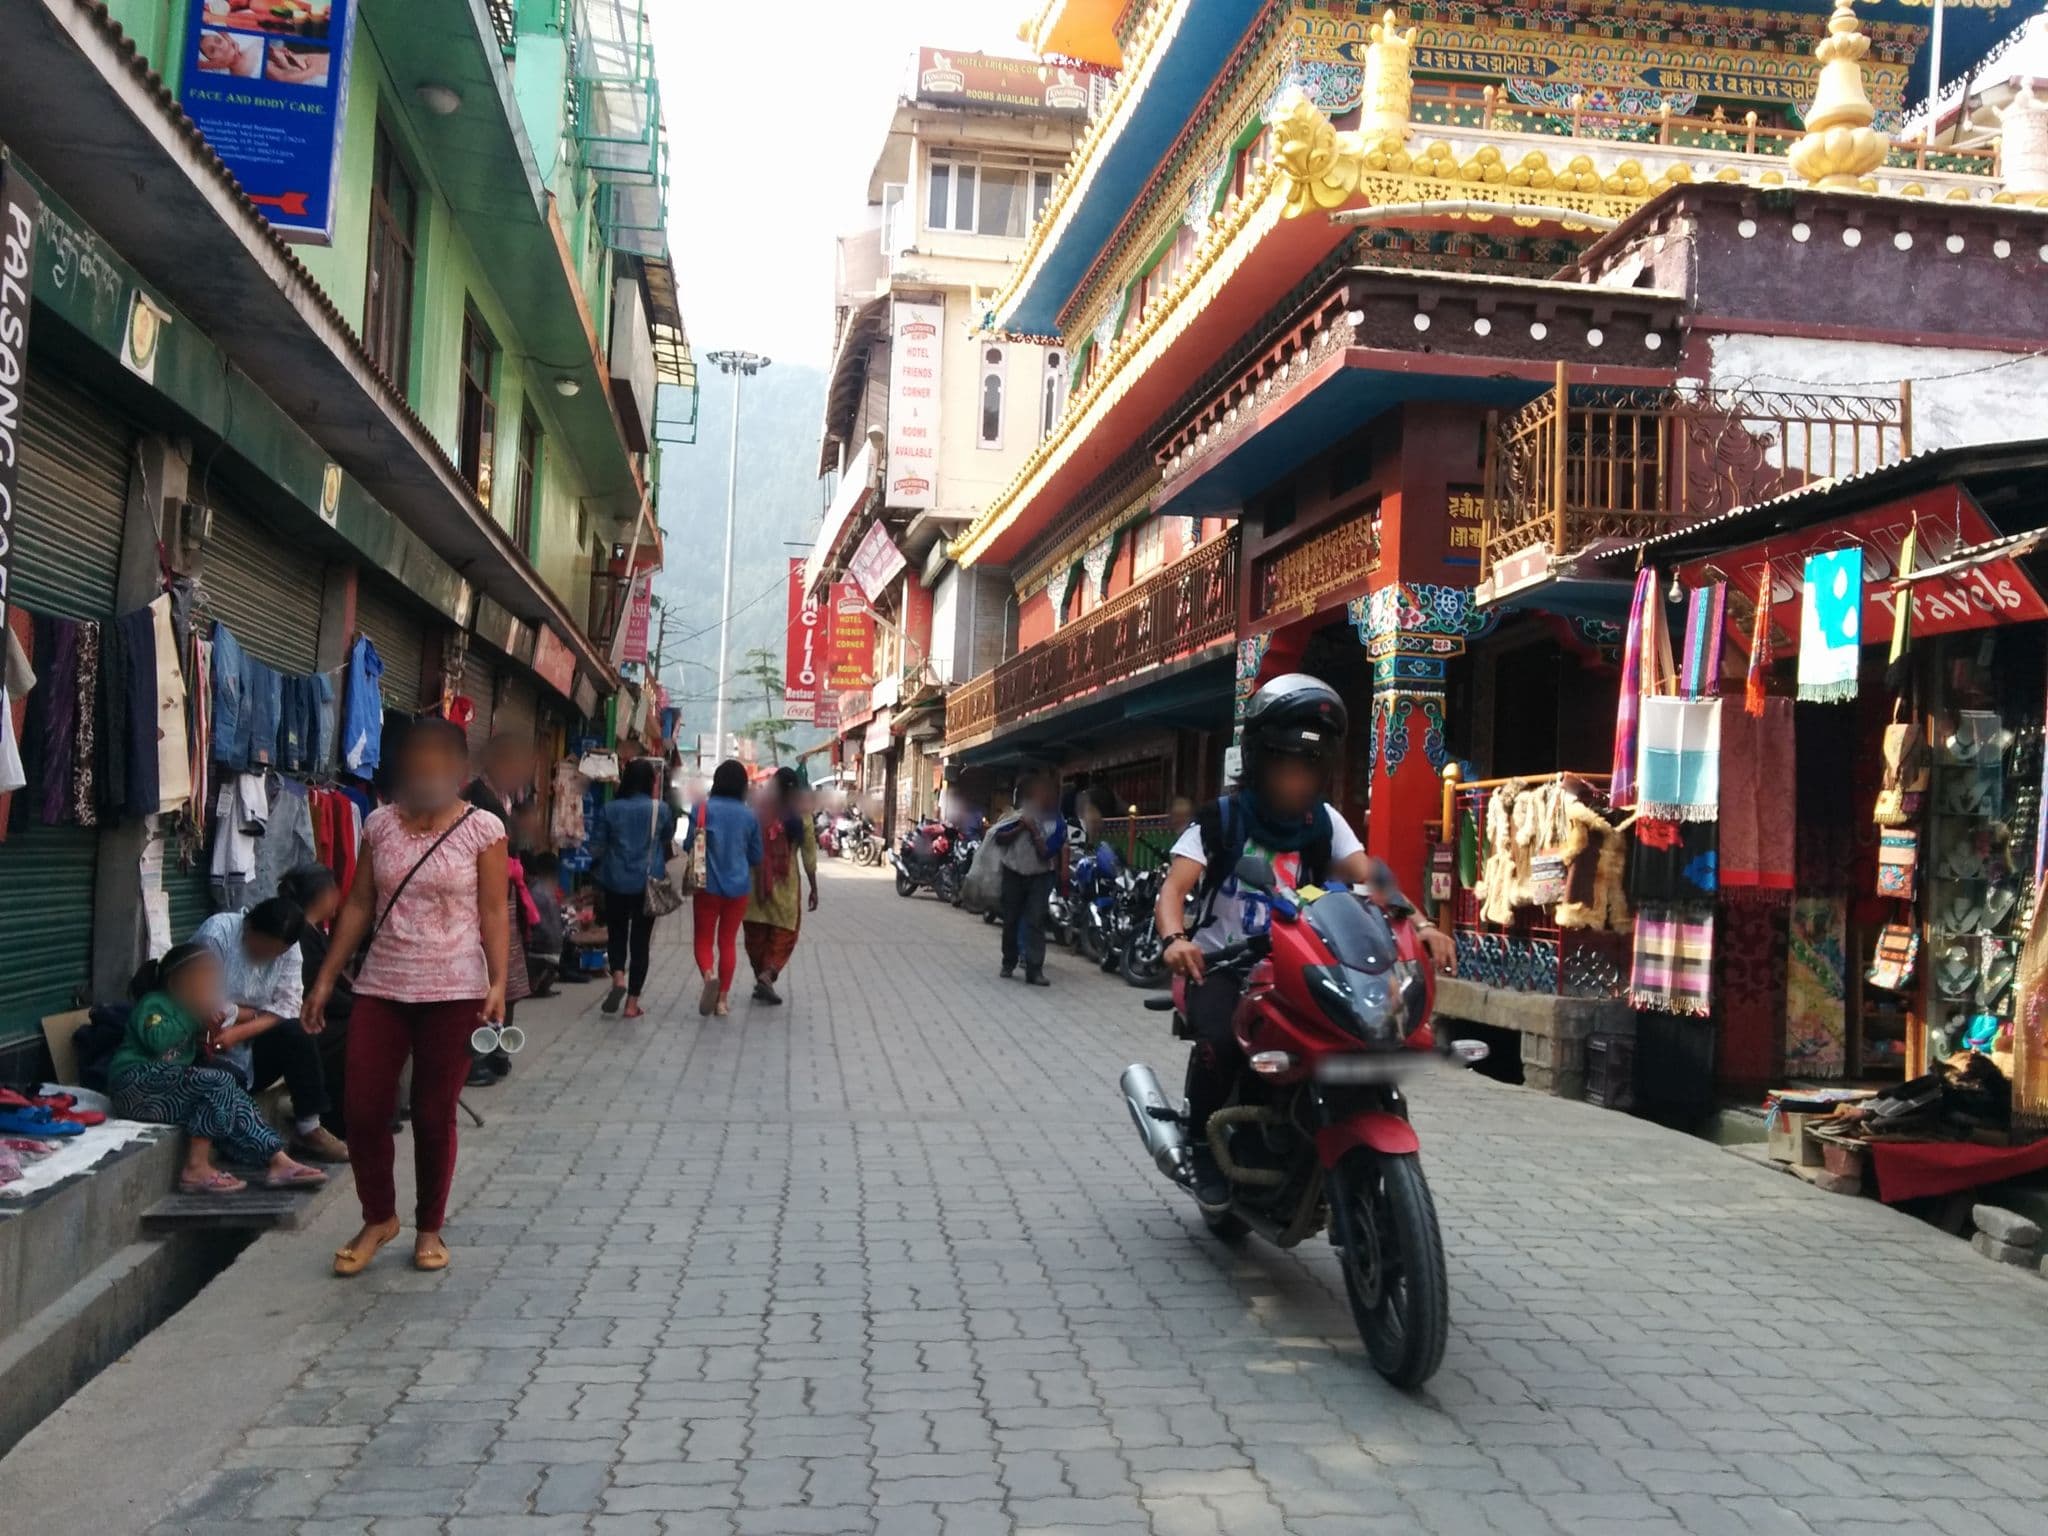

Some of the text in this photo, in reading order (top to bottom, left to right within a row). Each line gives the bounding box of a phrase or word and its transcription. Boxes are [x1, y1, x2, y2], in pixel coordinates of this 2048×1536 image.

[956, 57, 1054, 77] HOTEL FRIENDS CORR
[189, 88, 223, 100] FACE
[226, 93, 251, 104] AND
[254, 96, 288, 109] BODY
[966, 89, 1040, 106] ROOMS AVAILABLE
[906, 347, 929, 358] HOTEL
[903, 366, 933, 378] FRIENDS
[902, 386, 930, 398] CORNER
[902, 426, 927, 438] ROOMS
[895, 446, 932, 458] AVAILABLE
[1741, 514, 1971, 604] BUDHA
[836, 628, 865, 636] FRIENDS
[837, 665, 862, 673] ROOMS
[786, 687, 815, 699] Restaur
